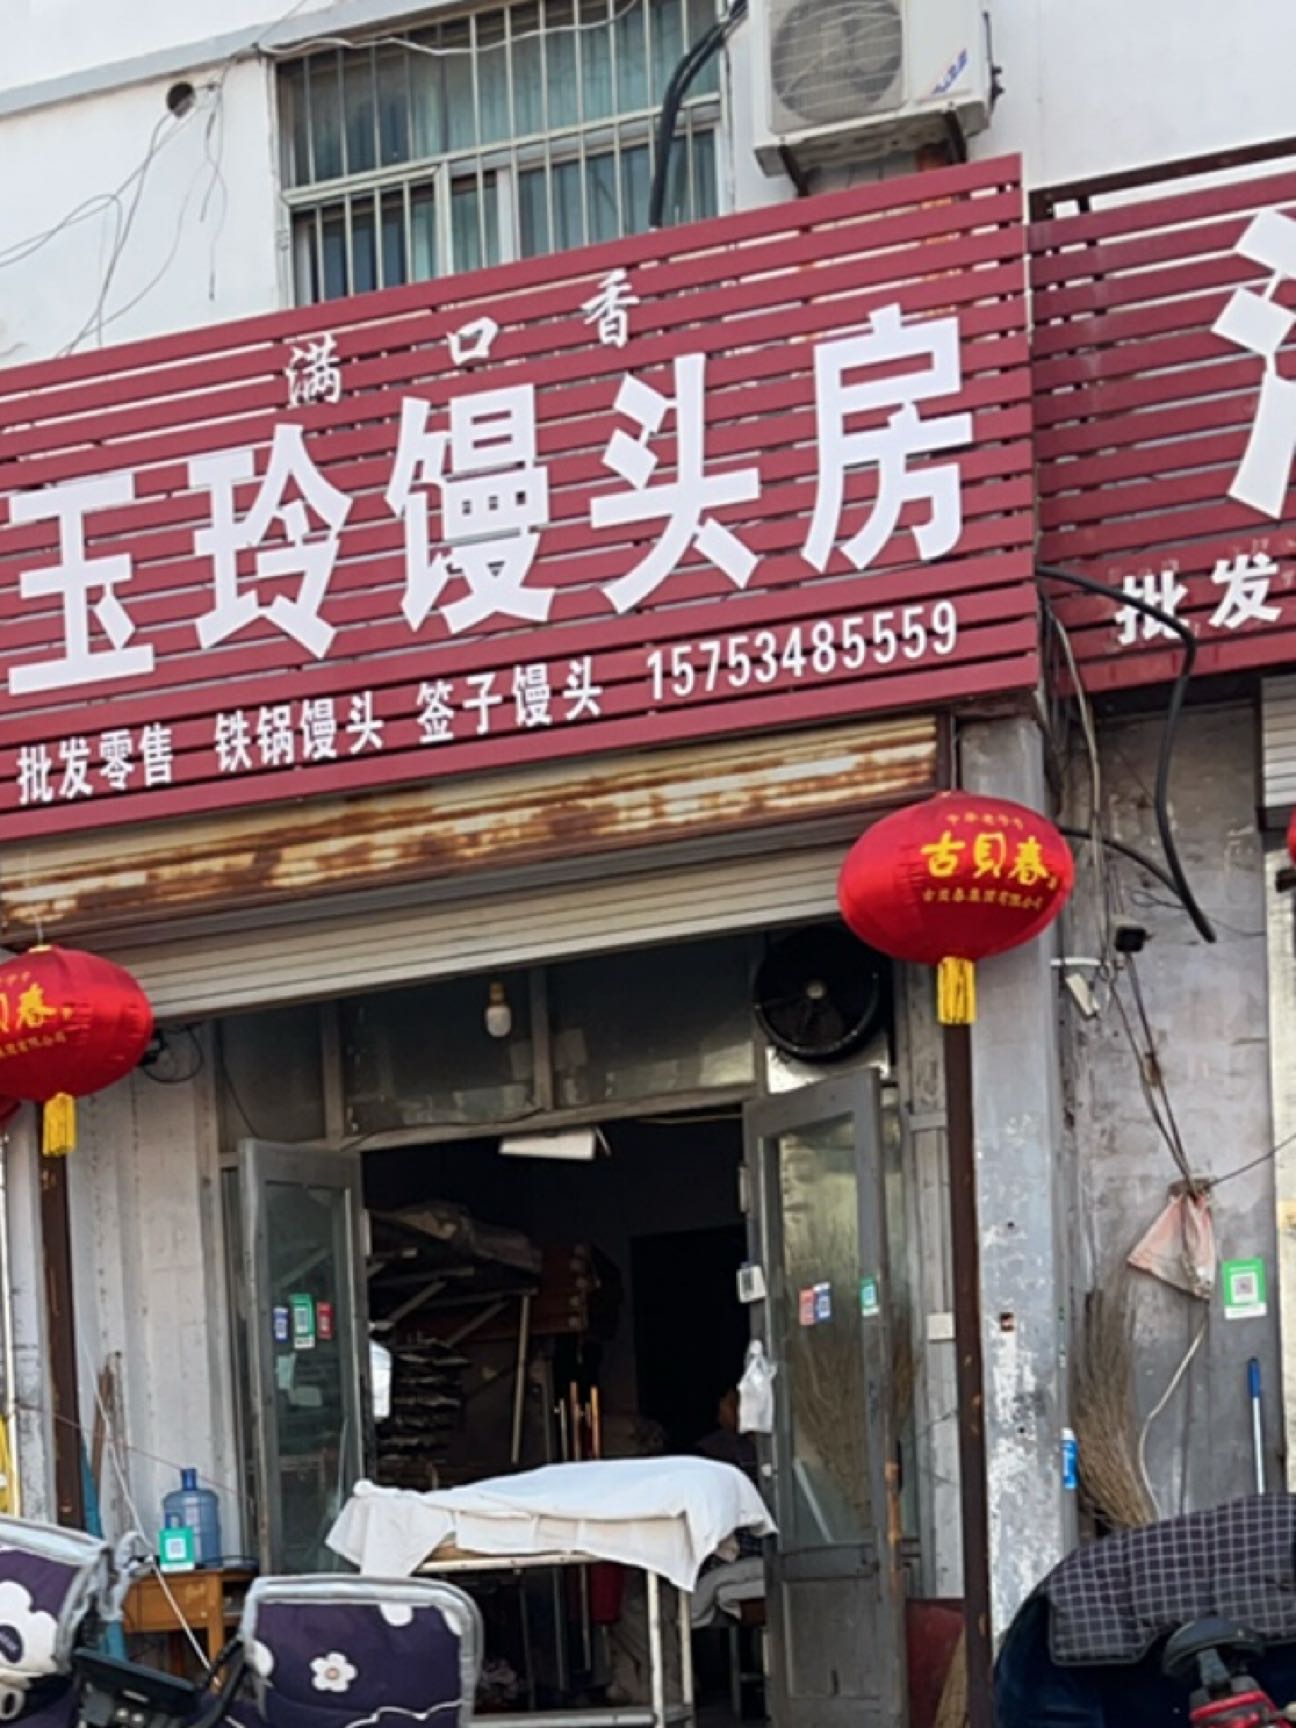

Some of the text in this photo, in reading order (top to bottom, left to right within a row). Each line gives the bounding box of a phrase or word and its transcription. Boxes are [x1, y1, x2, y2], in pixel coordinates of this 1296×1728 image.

[284, 268, 639, 406] 满口香
[8, 302, 973, 695] 玉玲馒头房
[1115, 552, 1282, 646] 批发
[16, 599, 959, 804] 批发零售 铁锅馒头 签子馒头 15753485559
